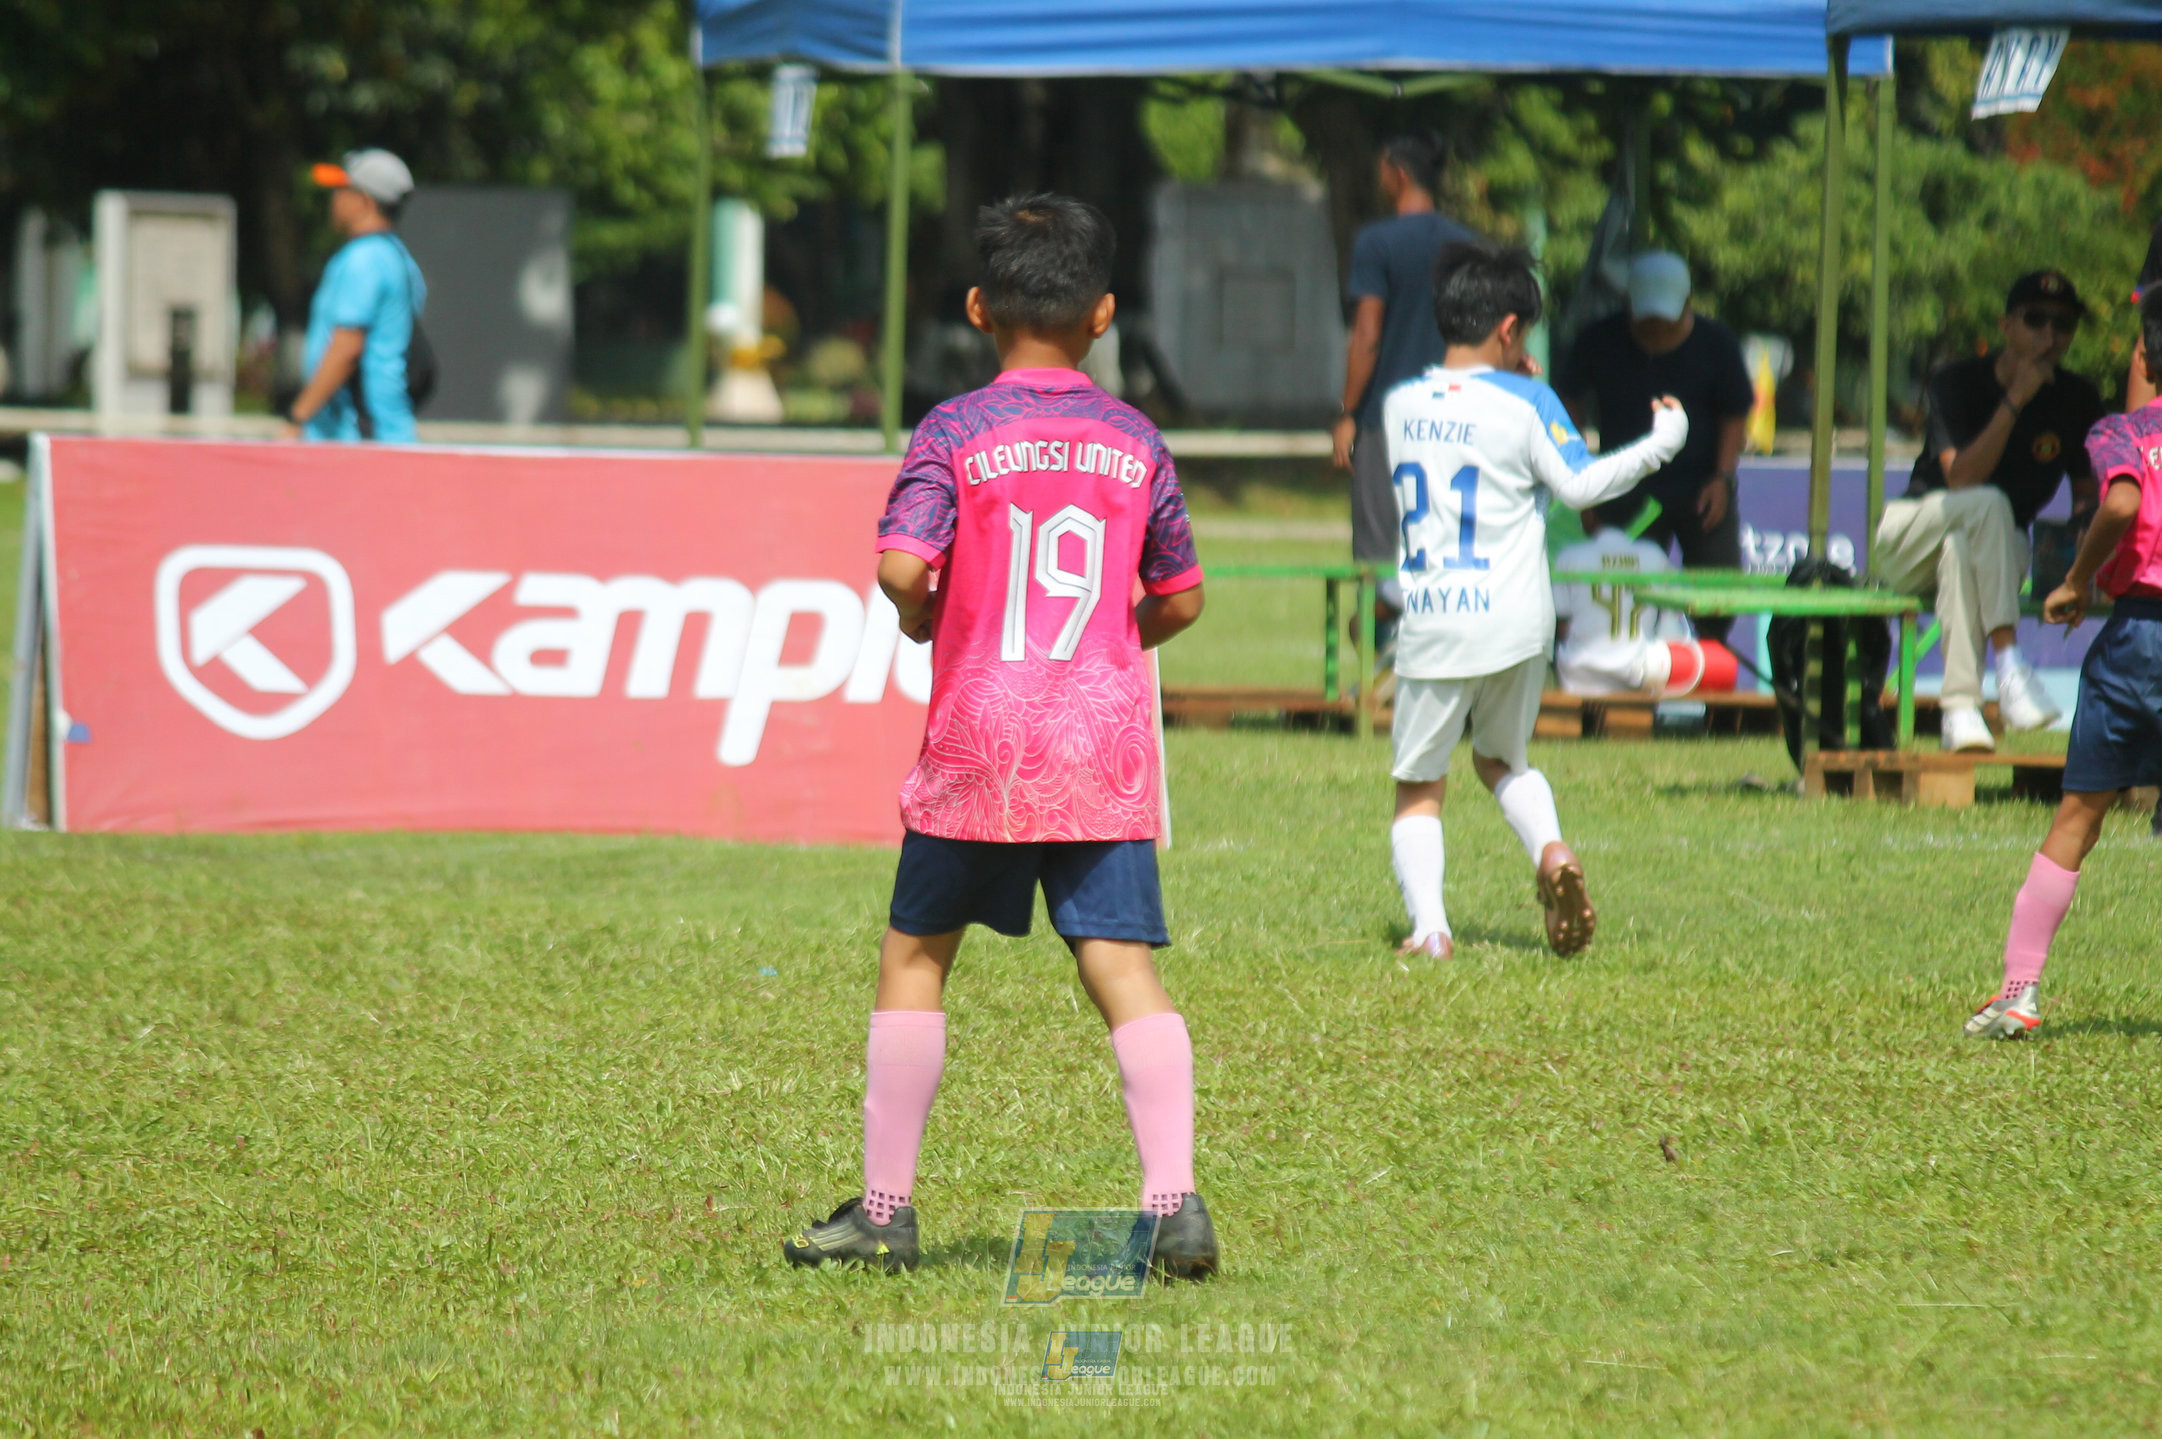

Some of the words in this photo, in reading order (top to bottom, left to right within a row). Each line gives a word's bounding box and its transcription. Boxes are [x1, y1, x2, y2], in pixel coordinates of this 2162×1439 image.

[964, 440, 1070, 486] CILEUNGSI
[1076, 441, 1148, 489] UNITED
[1404, 418, 1476, 446] KENZIE
[1393, 462, 1490, 571] 21
[1001, 502, 1107, 662] 19
